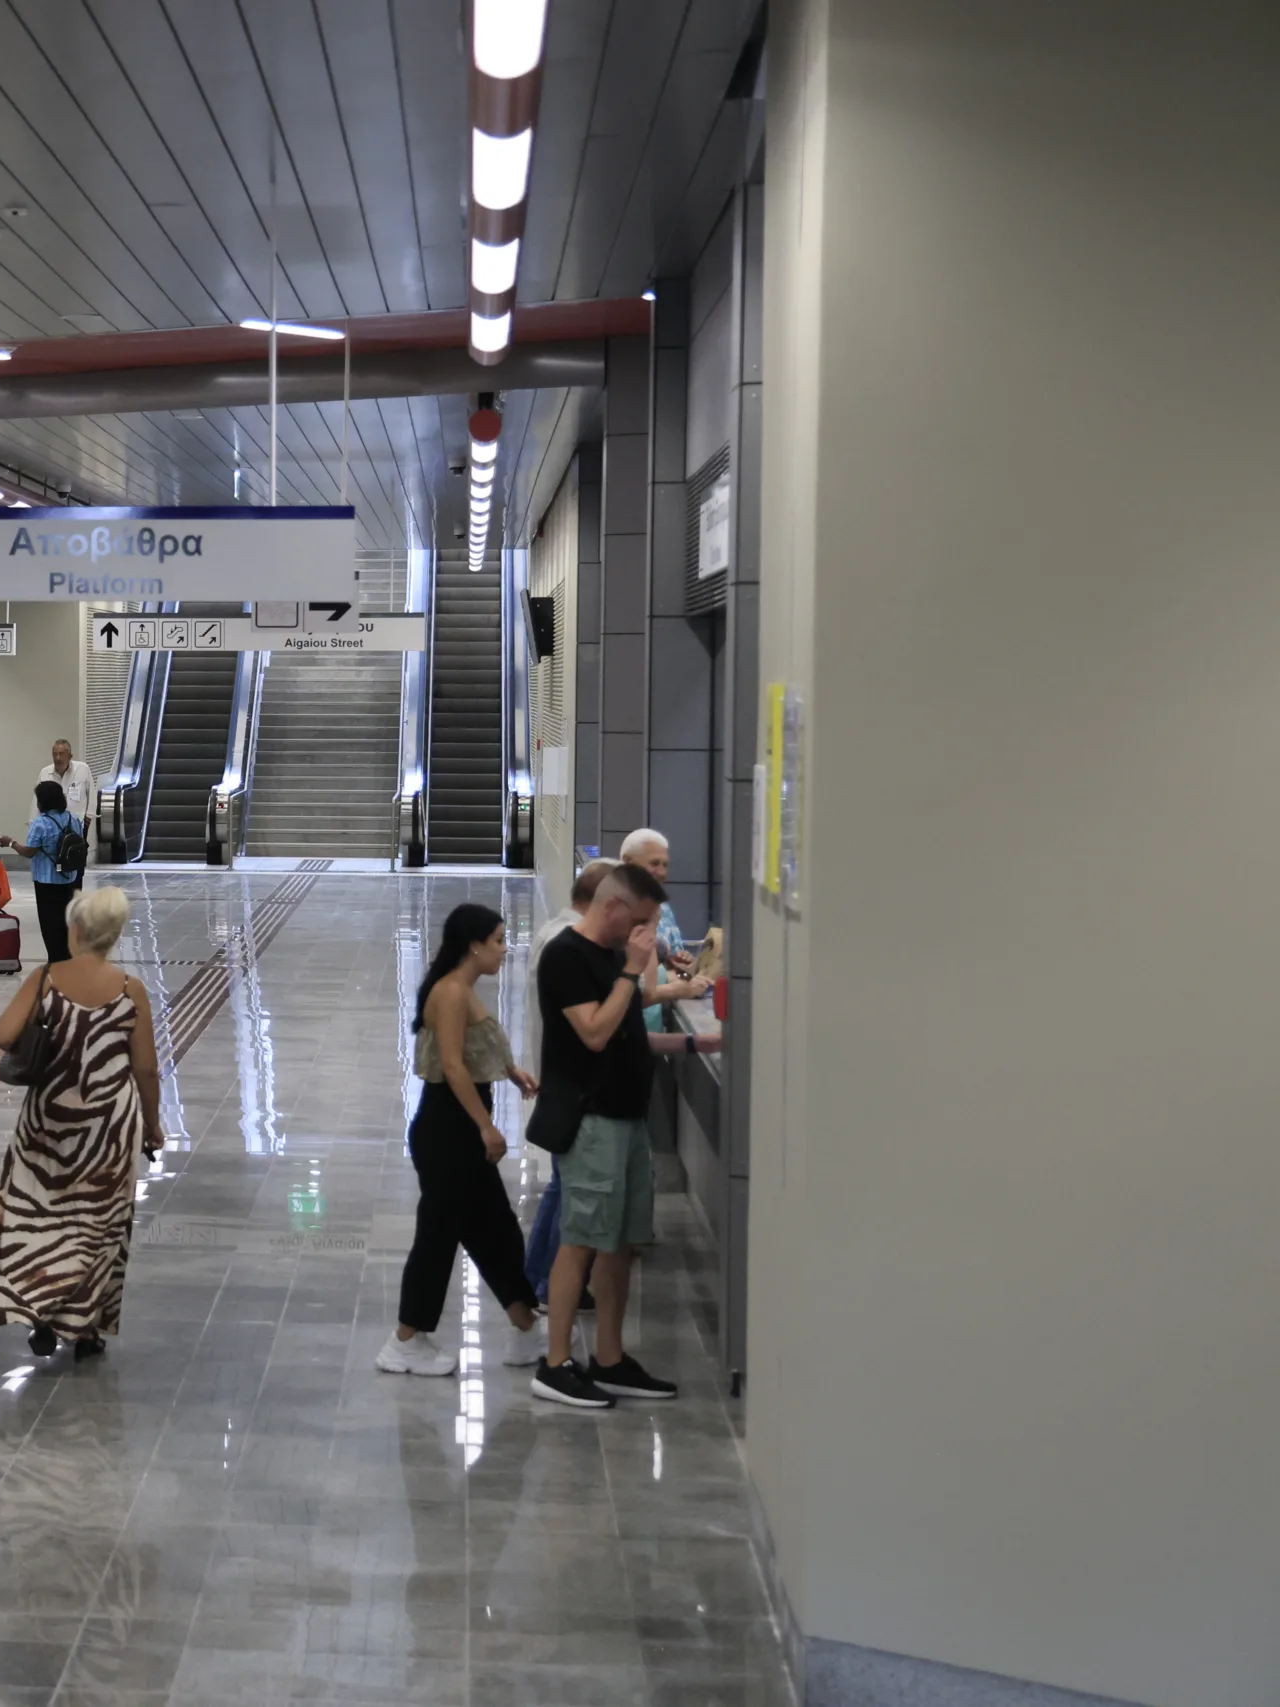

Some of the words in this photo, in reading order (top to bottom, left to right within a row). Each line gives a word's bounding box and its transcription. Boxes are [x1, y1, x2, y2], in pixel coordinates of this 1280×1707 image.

[9, 526, 203, 563] Αποβάθρα
[49, 572, 163, 594] Platform
[285, 638, 327, 649] Aigaiou
[330, 638, 364, 648] Street
